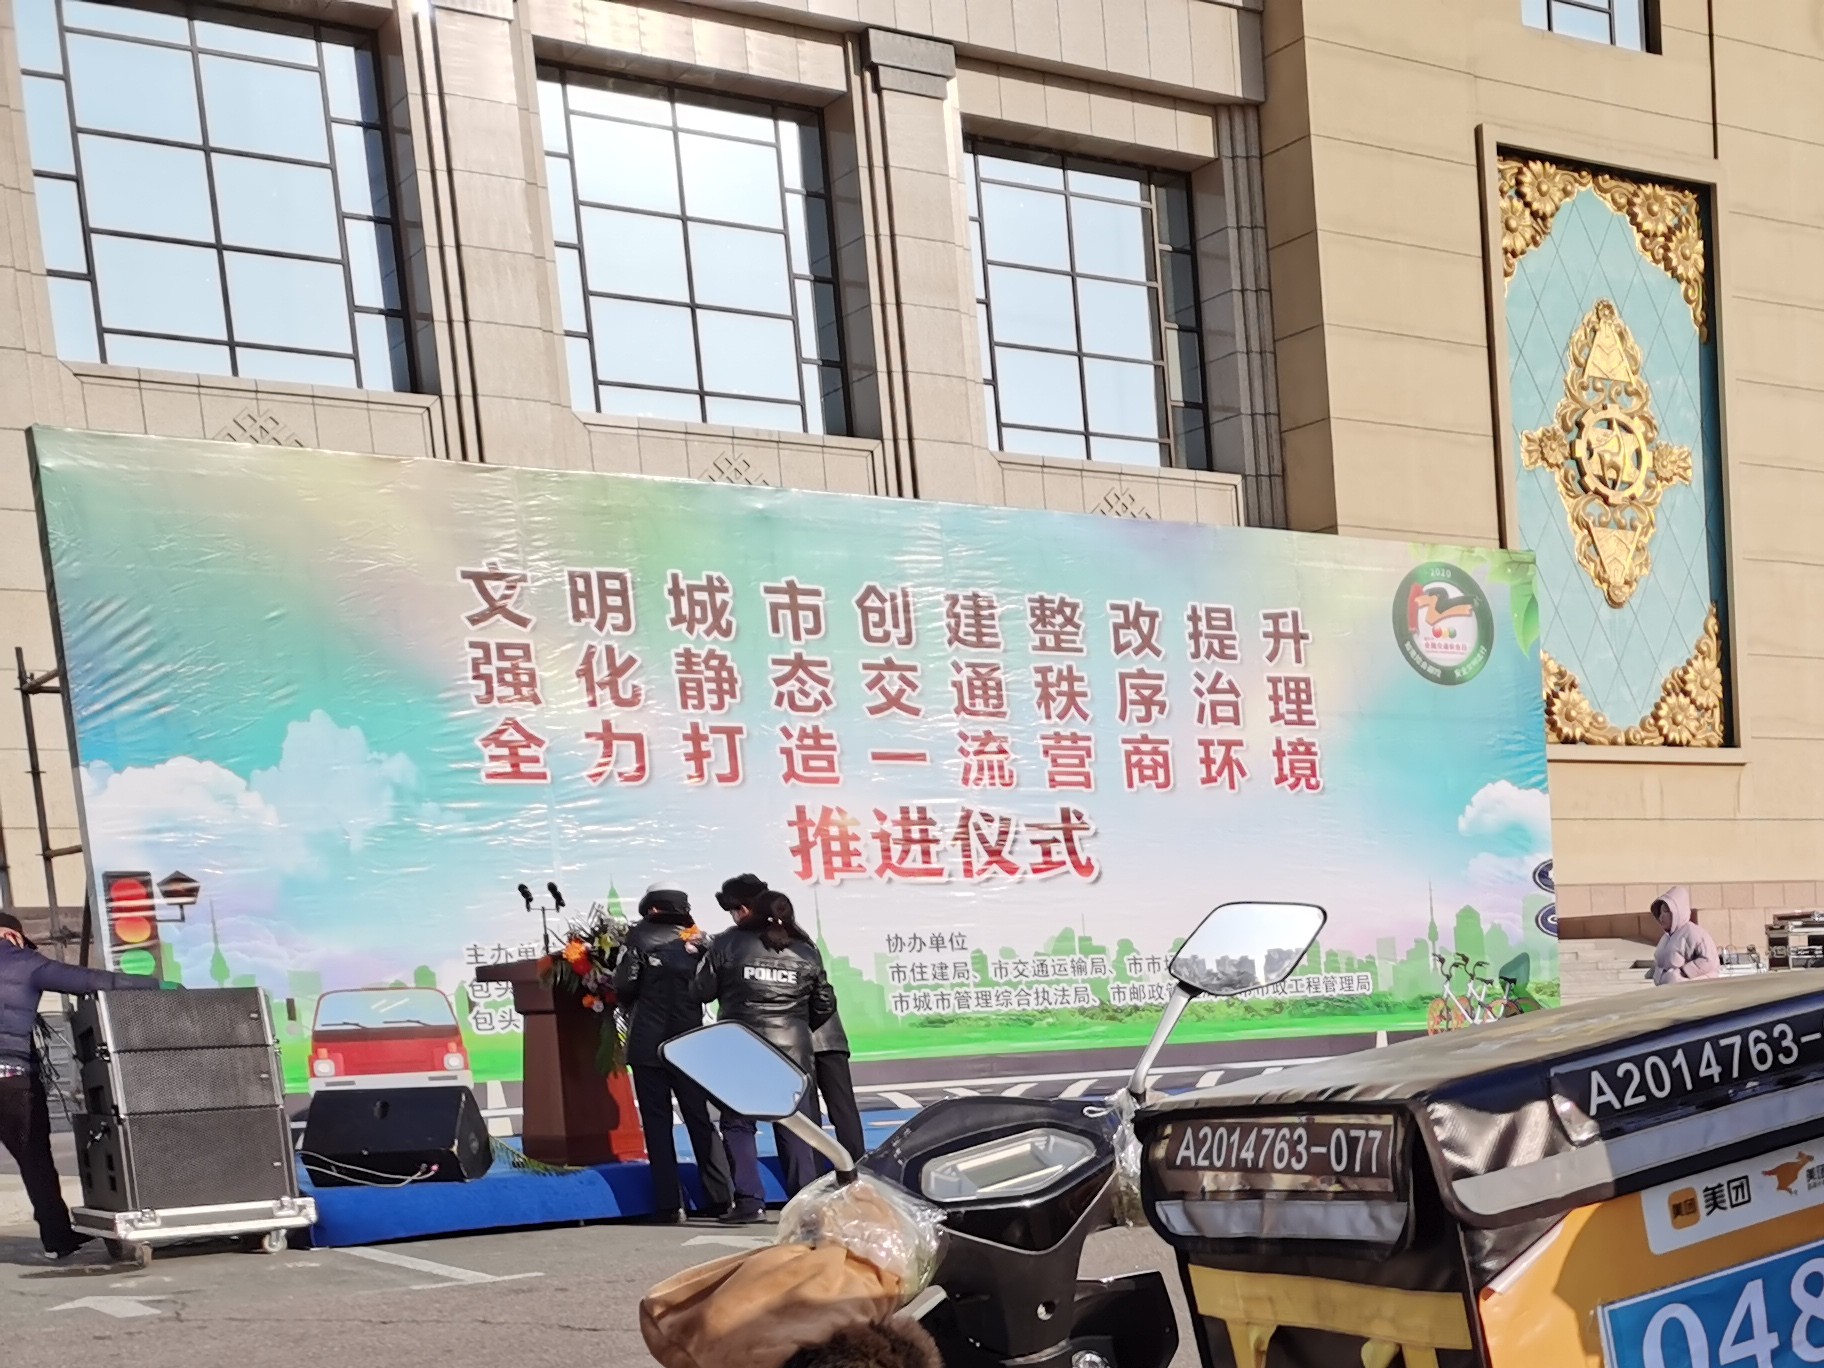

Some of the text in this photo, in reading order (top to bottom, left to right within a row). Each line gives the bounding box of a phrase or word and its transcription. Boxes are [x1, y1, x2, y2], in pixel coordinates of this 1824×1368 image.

[459, 562, 1312, 665] 文明城市创建整改提升
[468, 641, 1318, 728] 强化静态交通秩序治理
[478, 717, 1323, 791] 全力打造一流营商环境
[788, 804, 1097, 881] 推进仪式
[886, 932, 968, 953] 协办单位
[743, 966, 798, 984] POLICE
[1175, 1126, 1383, 1174] A2014763-077
[1703, 1174, 1751, 1217] 美团
